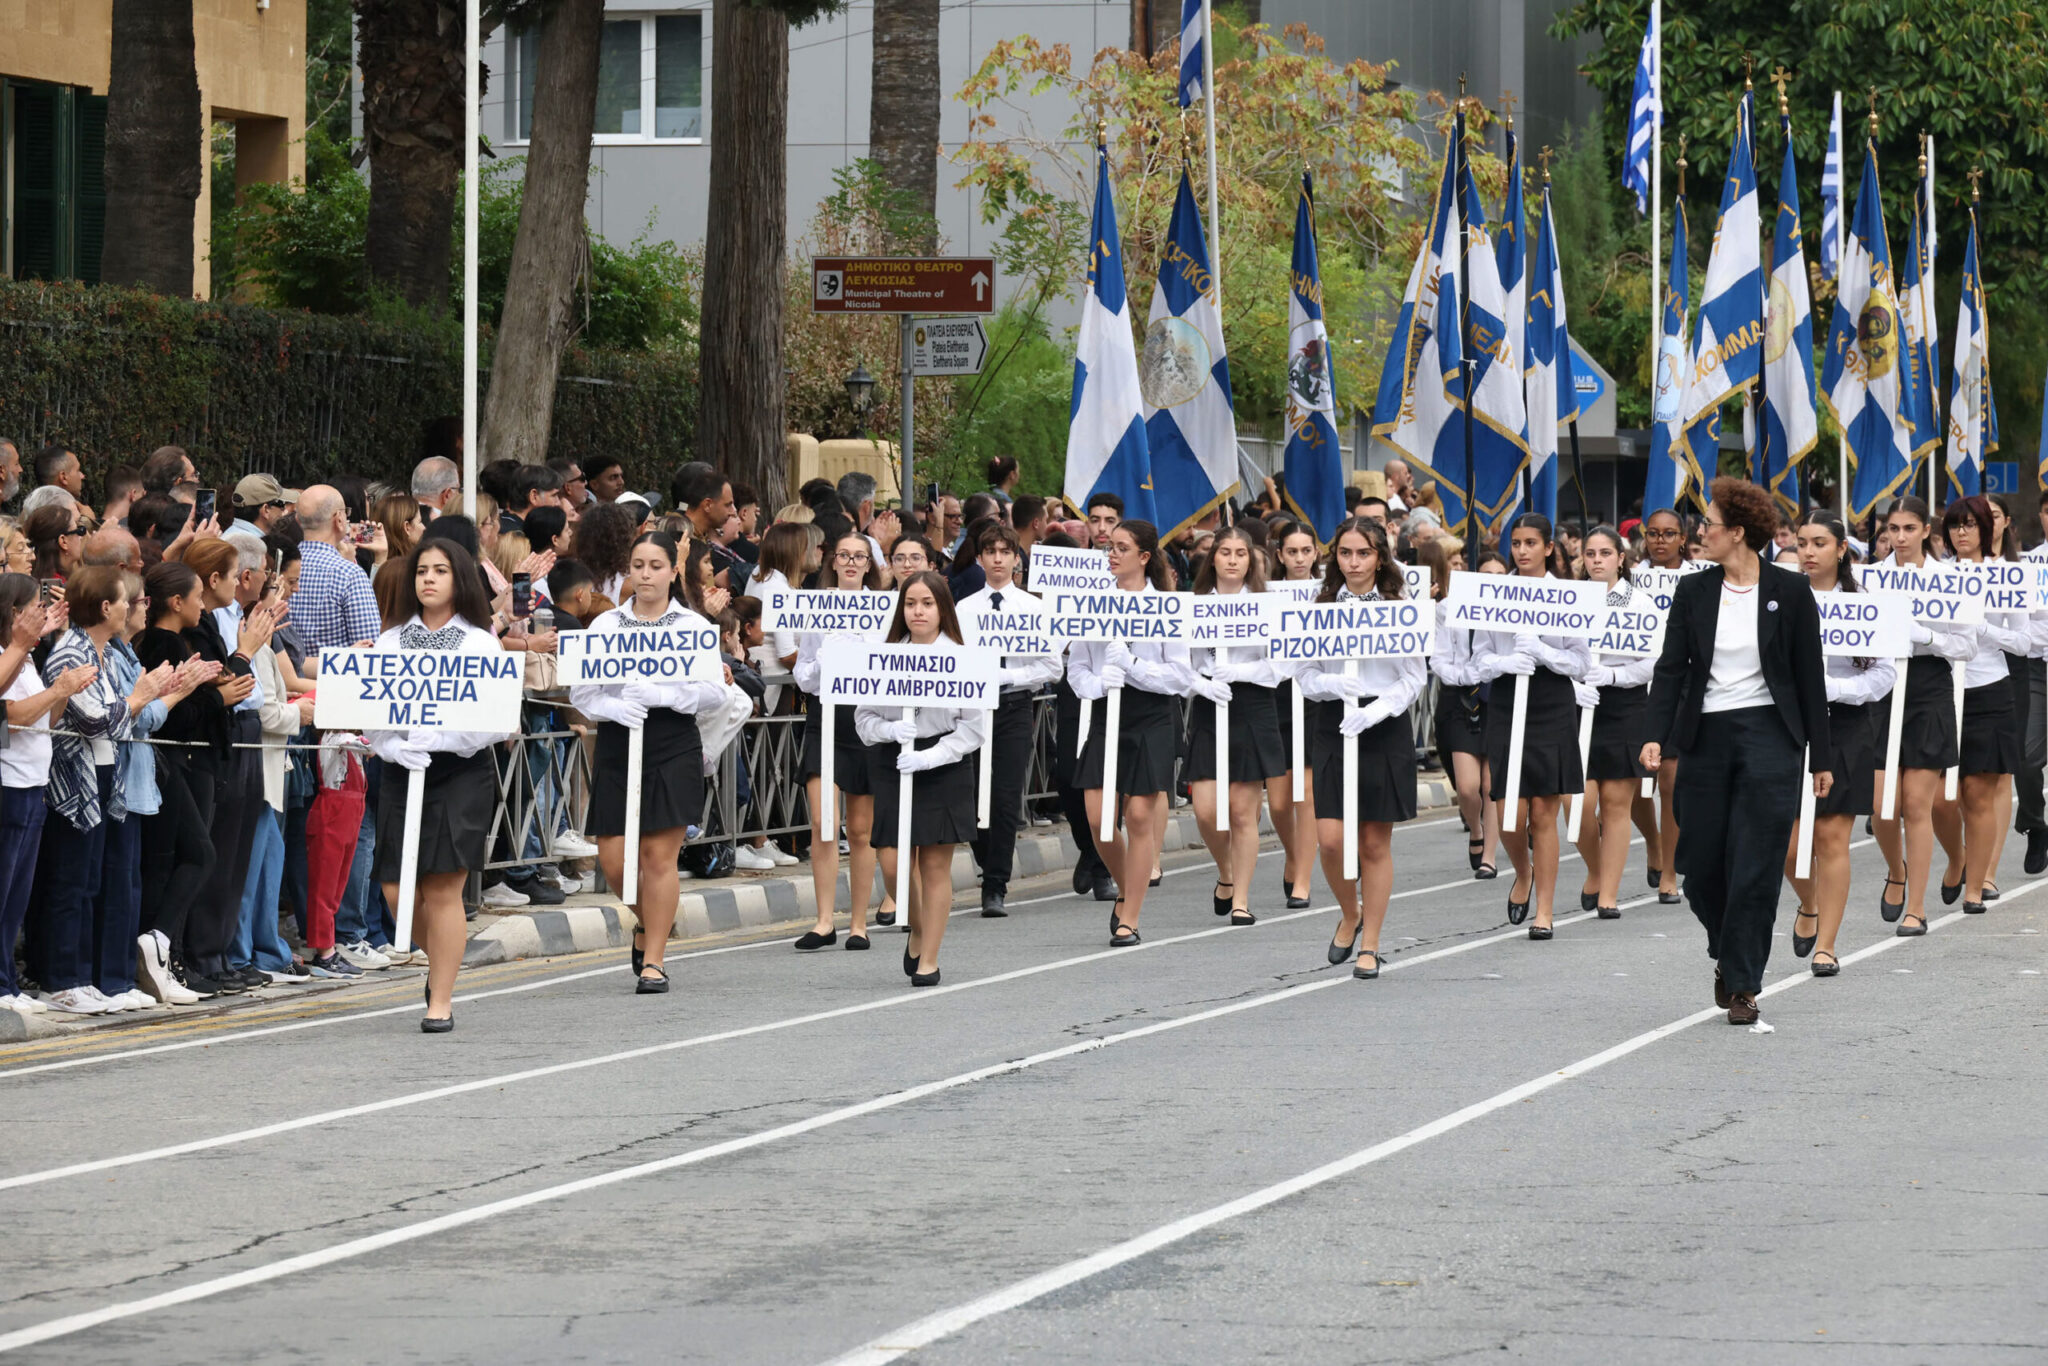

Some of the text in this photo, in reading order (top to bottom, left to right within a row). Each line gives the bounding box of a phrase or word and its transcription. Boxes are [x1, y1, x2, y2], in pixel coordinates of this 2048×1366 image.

[845, 262, 964, 273] ΔΗΜΟΤΙΚΟ ΘΕΑΤΡΟ
[845, 275, 916, 286] ΛΕΥΚΩΣΙΑΣ
[845, 289, 944, 299] Municipal Theatre of
[845, 300, 881, 308] Nicosia
[1033, 553, 1102, 570] ΤΕΧΝΙΚΗ
[1037, 573, 1111, 590] ΑΜΜΟΧΩ
[1862, 568, 1982, 596] ΓΥΜΝΑΣΙΟ
[795, 594, 891, 611] ΓΥΜΝΑΣΙΟ
[1056, 594, 1181, 615] ΓΥΜΝΑΣΙΟ
[1479, 583, 1577, 606] ΓΥΜΝΑΣΙΟ
[1193, 602, 1259, 618] ΕΧΝΙΚΗ
[1281, 604, 1418, 632] ΓΥΜΝΑΣΙΟ
[1456, 604, 1595, 629] ΛΕΥΚΟΝΟΙΚΟΥ
[776, 613, 885, 631] ΑΜ/ΧΩΣΤΟΥ
[1050, 616, 1183, 638] ΚΕΡΥΝΕΙΑΣ
[1605, 611, 1658, 631] ΑΣΙΟ
[585, 629, 718, 654] ΓΥΜΝΑΣΙΟ
[1270, 631, 1429, 660] ΡΙΖΟΚΑΡΠΑΣΟΥ
[321, 652, 518, 679] ΚΑΤΕΧΟΜΕΝΑ
[581, 656, 695, 679] ΜΟΡΦΟΥ
[868, 653, 956, 674] ΓΥΜΝΑΣΙΟ
[359, 678, 479, 702] ΣΧΟΛΕΙΑ
[831, 676, 987, 699] ΑΓΙΟΥ ΑΜΒΡΟΣΙΟΥ
[388, 702, 443, 726] Μ.Ε.
